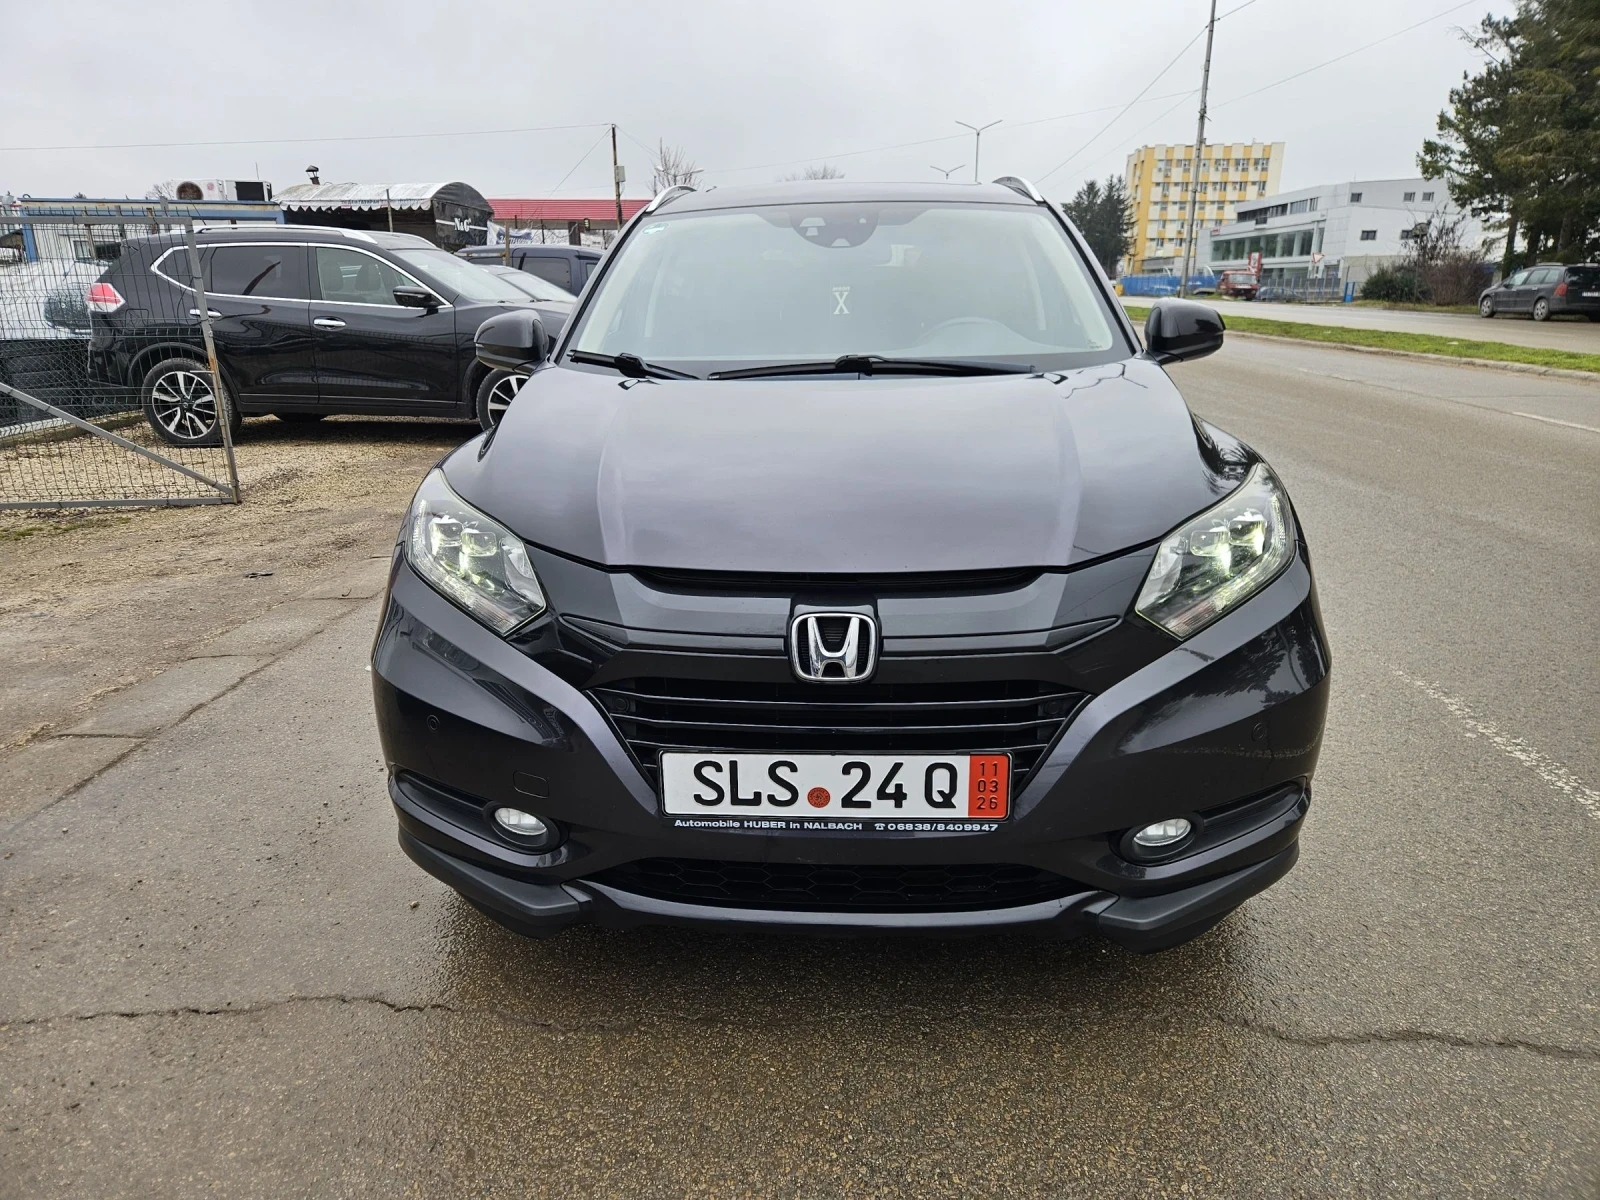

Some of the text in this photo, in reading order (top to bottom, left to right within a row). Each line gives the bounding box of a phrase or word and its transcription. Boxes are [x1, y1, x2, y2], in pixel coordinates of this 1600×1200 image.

[979, 761, 999, 777] 11
[693, 760, 799, 807] SLS
[841, 762, 907, 809] 24
[924, 763, 958, 809] Q
[977, 778, 999, 793] 03
[976, 795, 999, 810] 26
[674, 819, 999, 832] Automobile HUBER in NALBACH 06838/8409947
